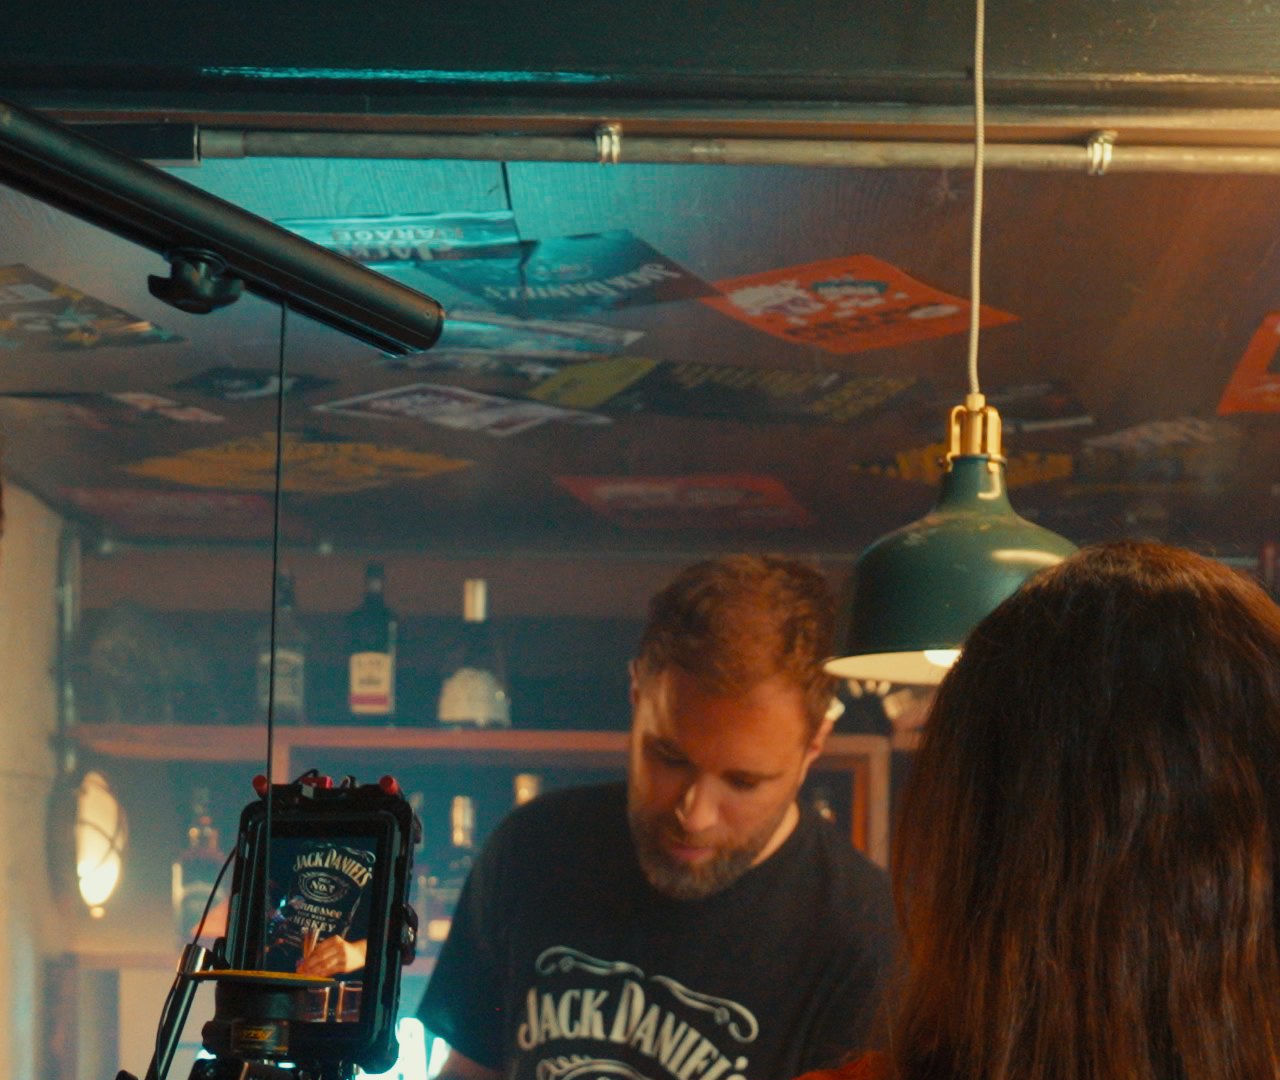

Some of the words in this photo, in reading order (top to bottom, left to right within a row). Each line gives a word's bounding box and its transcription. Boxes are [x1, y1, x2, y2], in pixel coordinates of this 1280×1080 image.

[293, 851, 324, 872] JACK
[323, 848, 373, 888] DANIEL'S
[518, 986, 610, 1050] JACK
